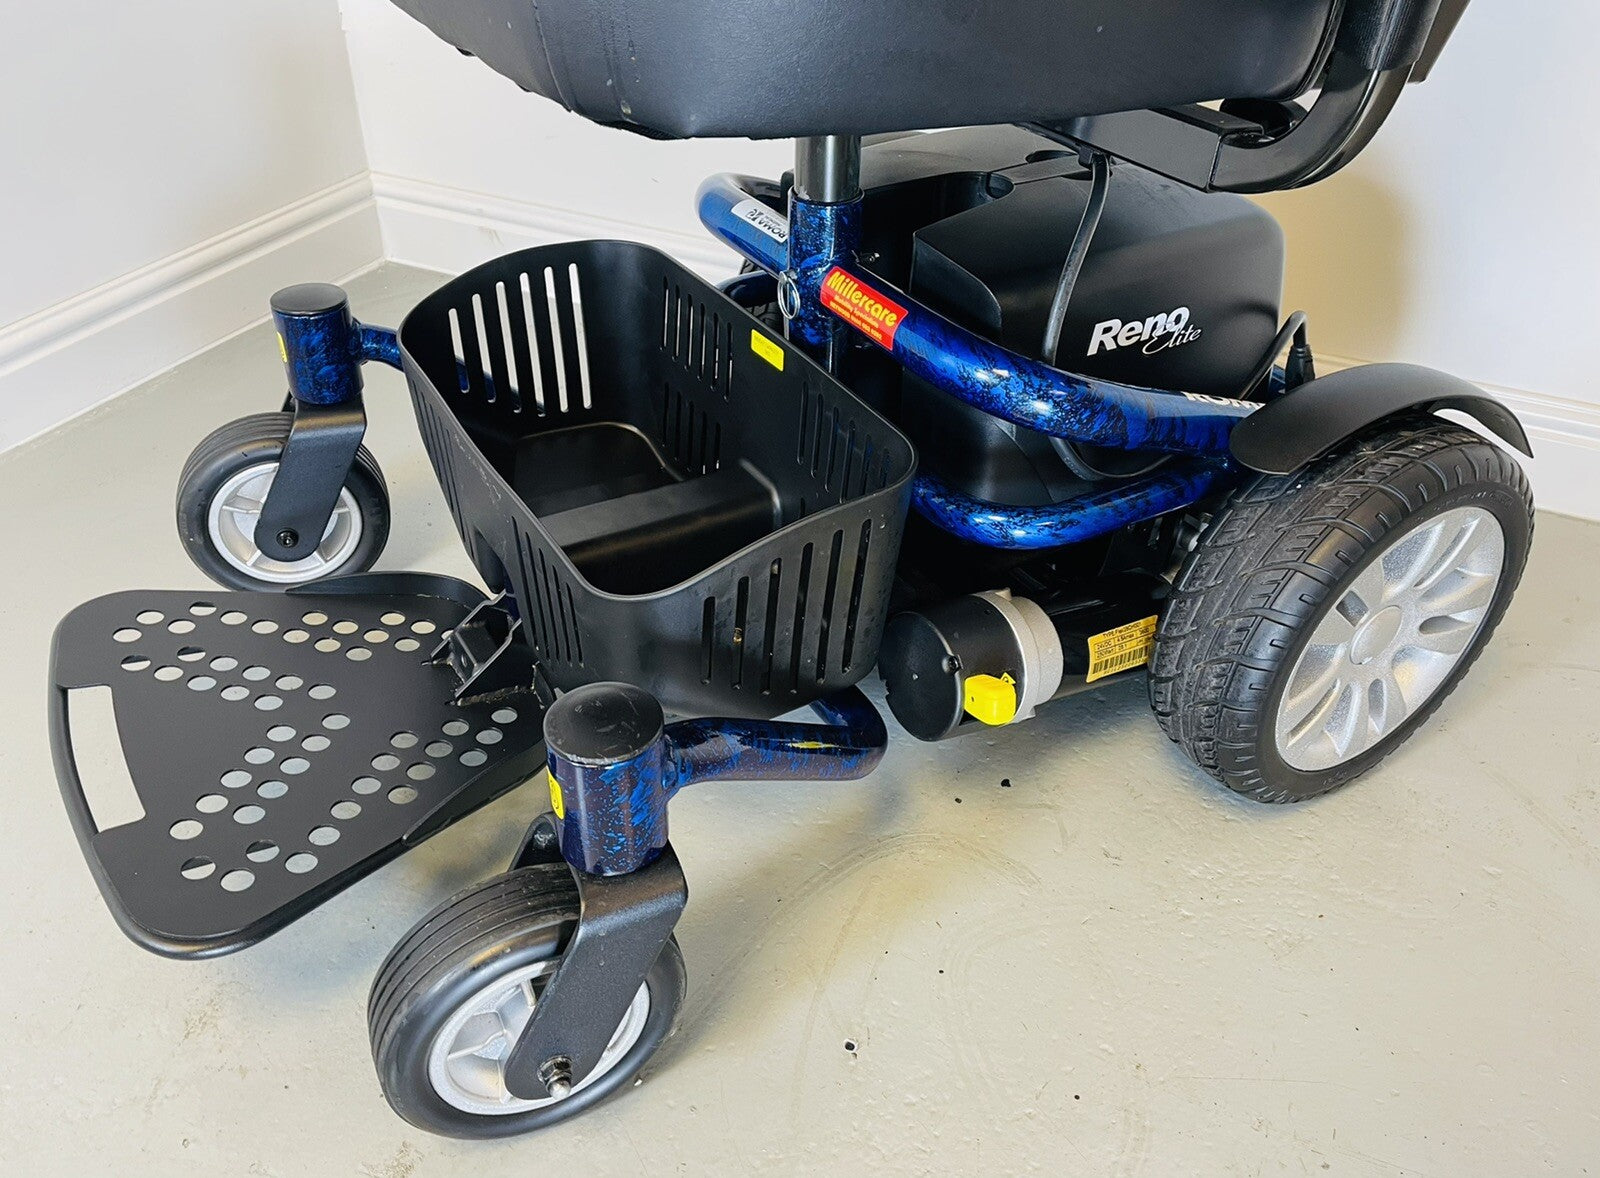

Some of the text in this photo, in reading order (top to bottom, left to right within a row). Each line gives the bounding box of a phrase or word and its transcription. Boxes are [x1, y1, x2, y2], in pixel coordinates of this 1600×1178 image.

[827, 271, 897, 327] Millercare
[1087, 306, 1190, 356] Reno
[1142, 324, 1201, 355] Elite
